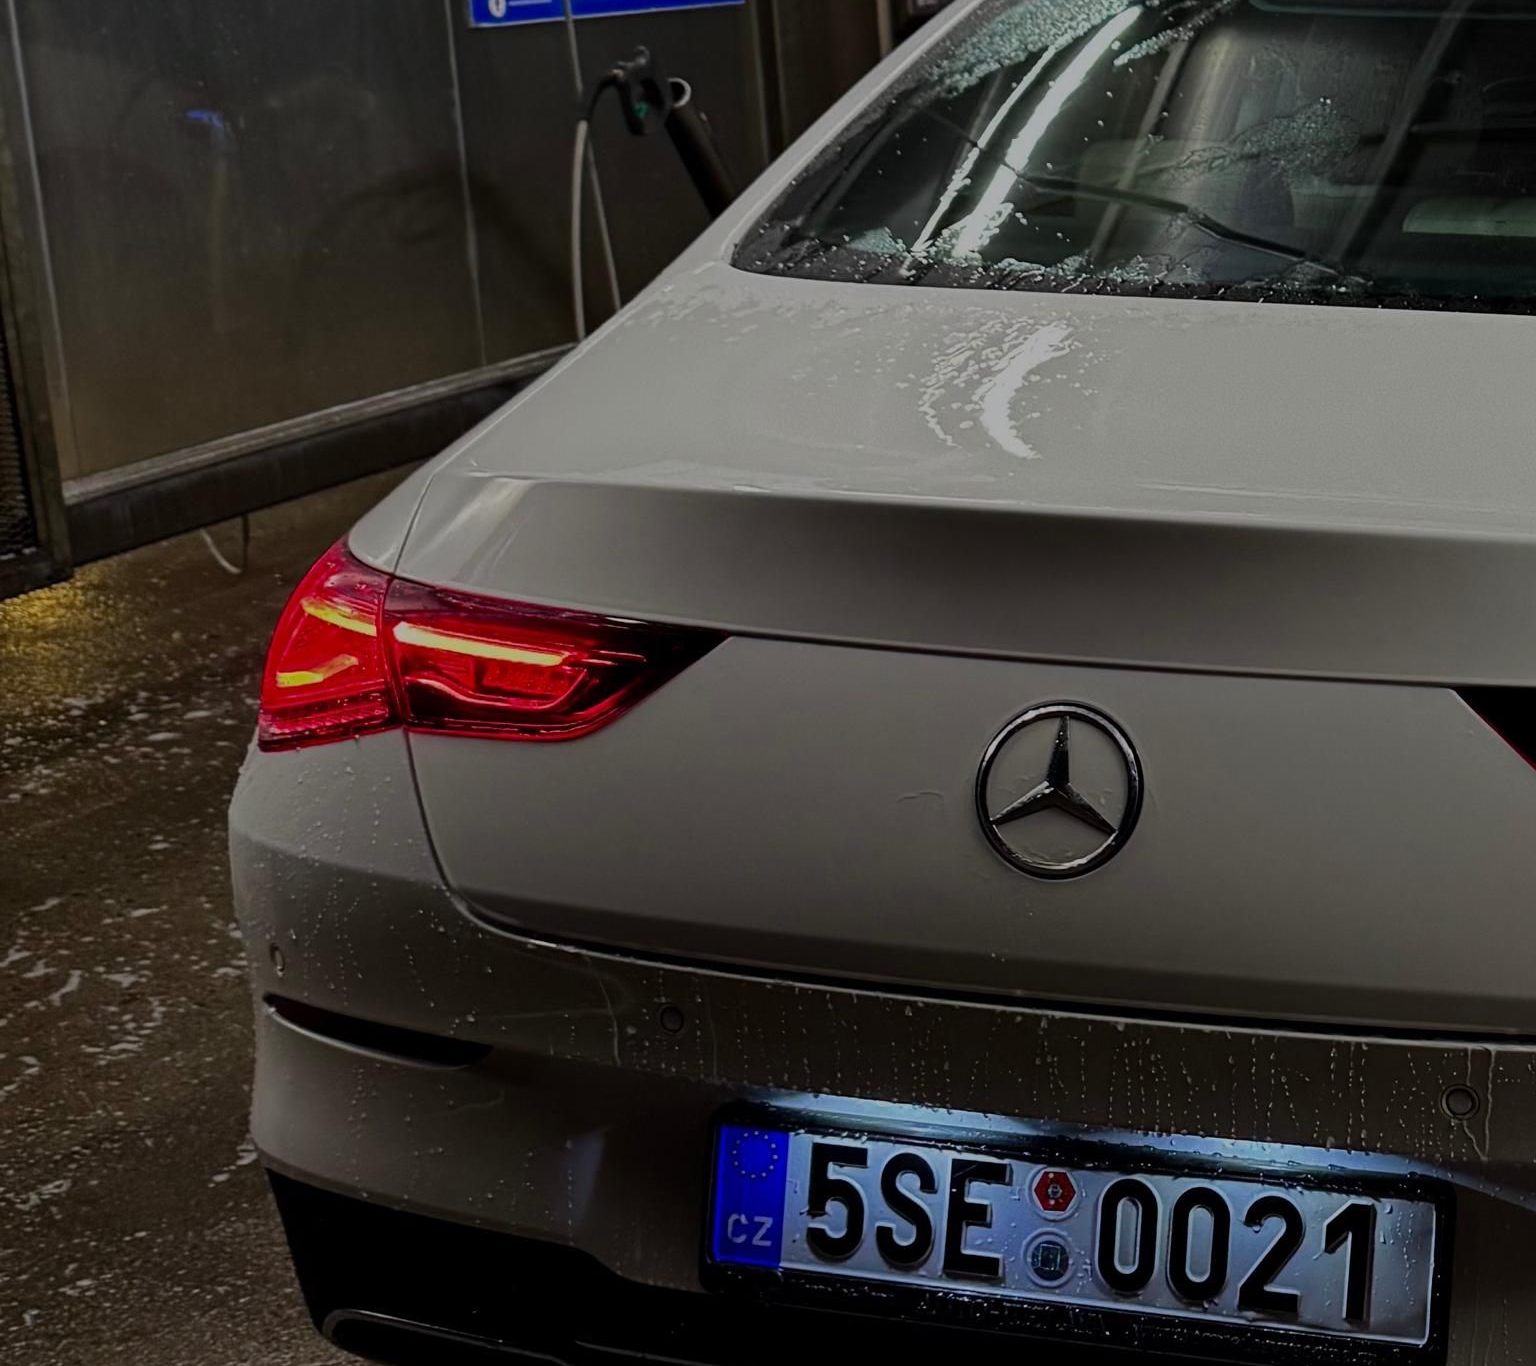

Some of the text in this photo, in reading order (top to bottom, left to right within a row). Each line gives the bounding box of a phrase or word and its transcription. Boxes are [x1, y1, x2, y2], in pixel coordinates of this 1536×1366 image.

[727, 1213, 774, 1247] CZ
[806, 1141, 1377, 1322] 5SE 0021
